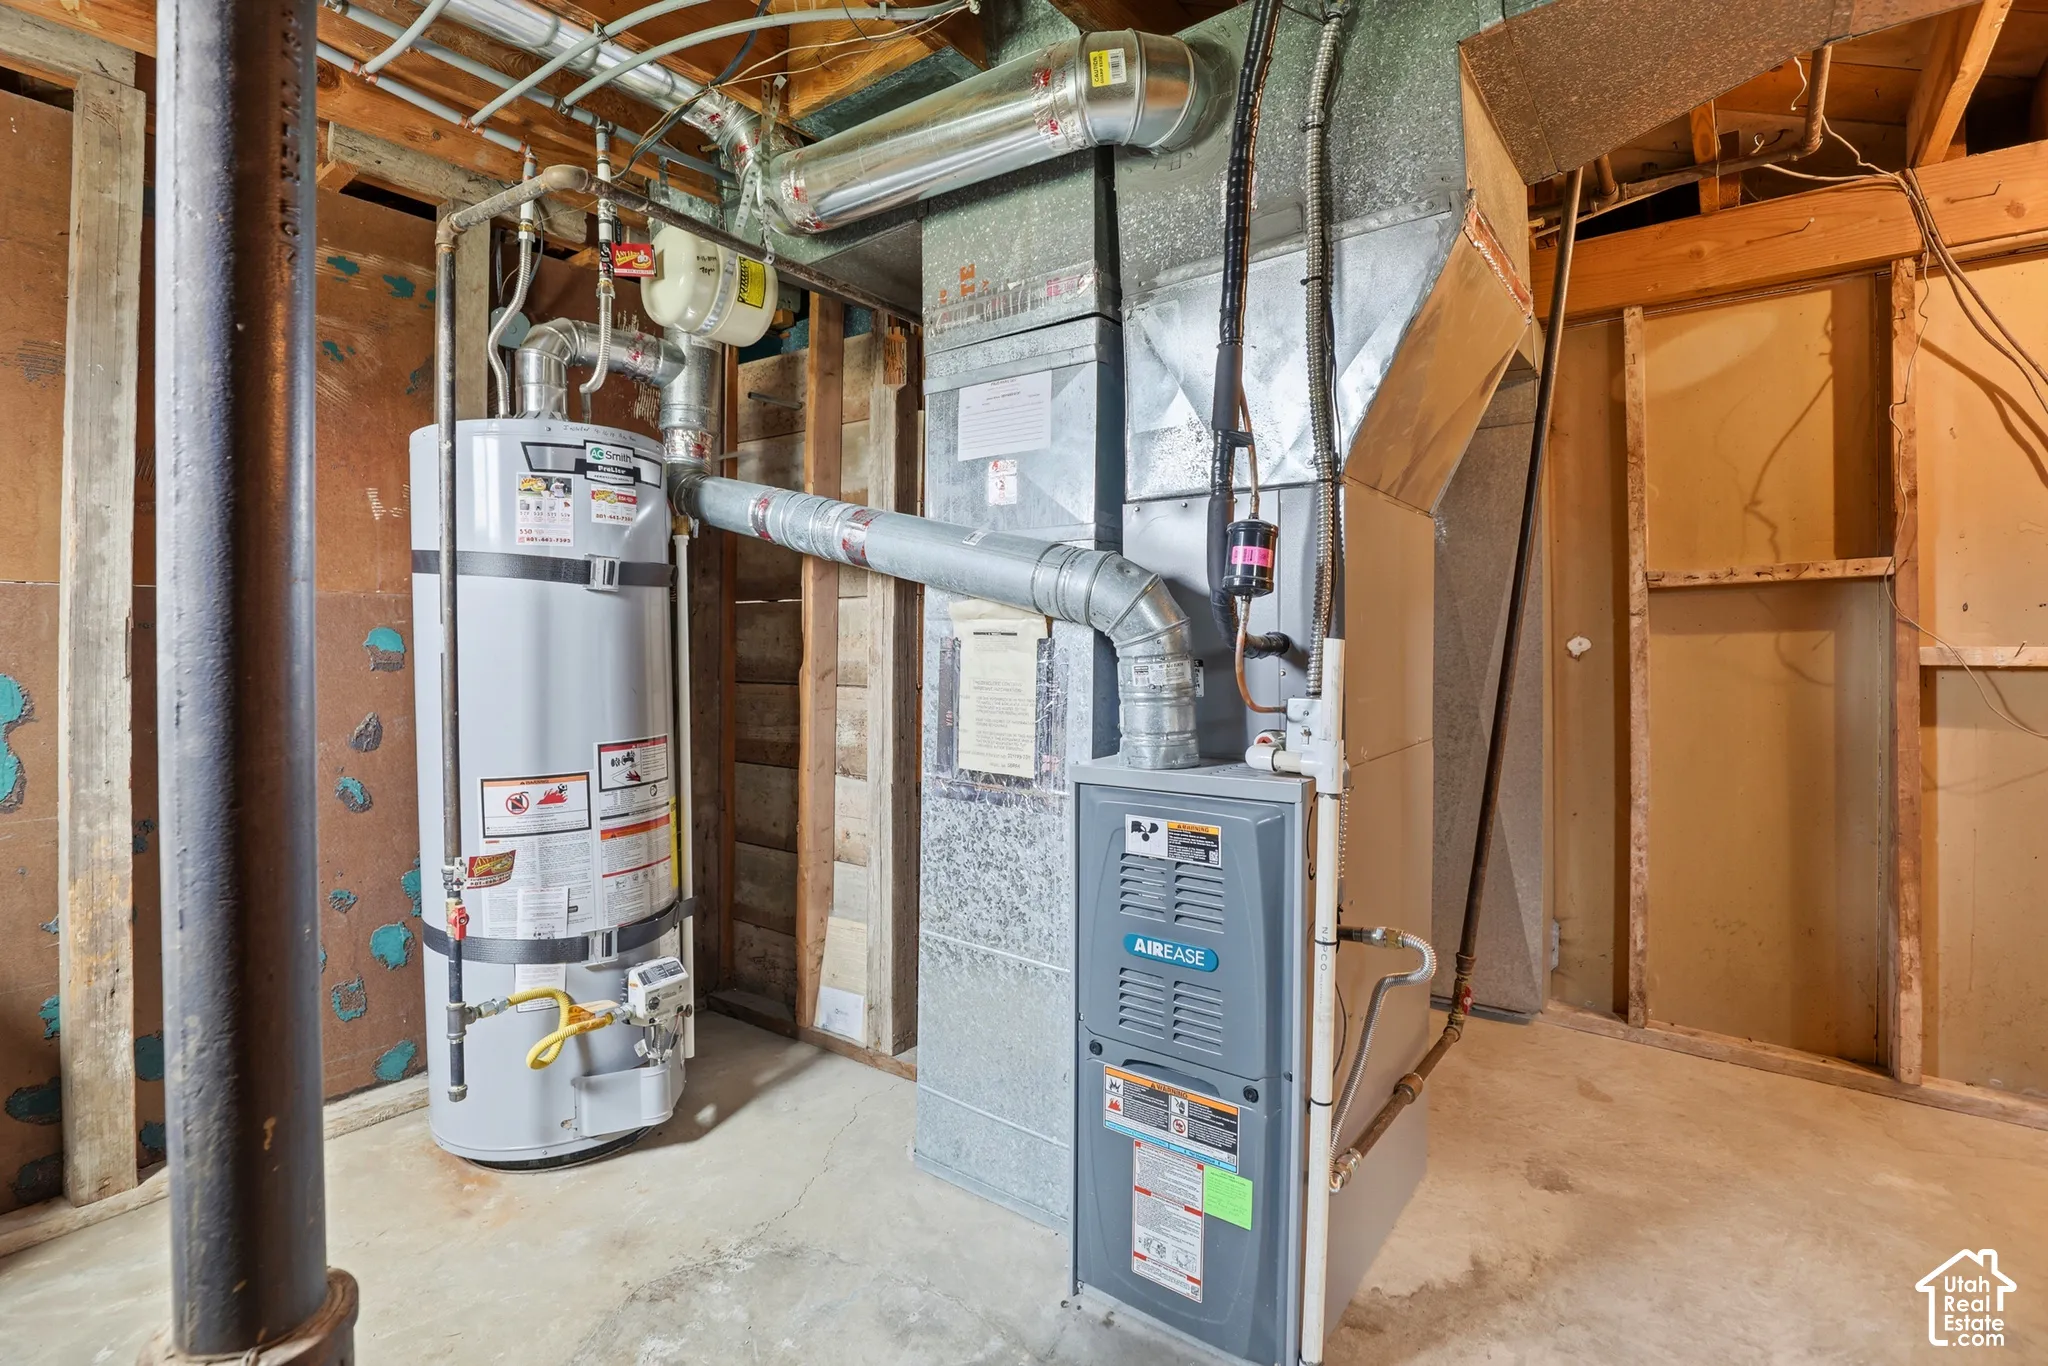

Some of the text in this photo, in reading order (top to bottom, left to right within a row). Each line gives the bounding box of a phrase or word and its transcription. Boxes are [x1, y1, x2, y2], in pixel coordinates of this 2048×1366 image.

[605, 450, 632, 463] Smith
[1182, 824, 1209, 833] WARNING
[1134, 937, 1205, 967] AIREASE
[1156, 1083, 1188, 1098] WARNING
